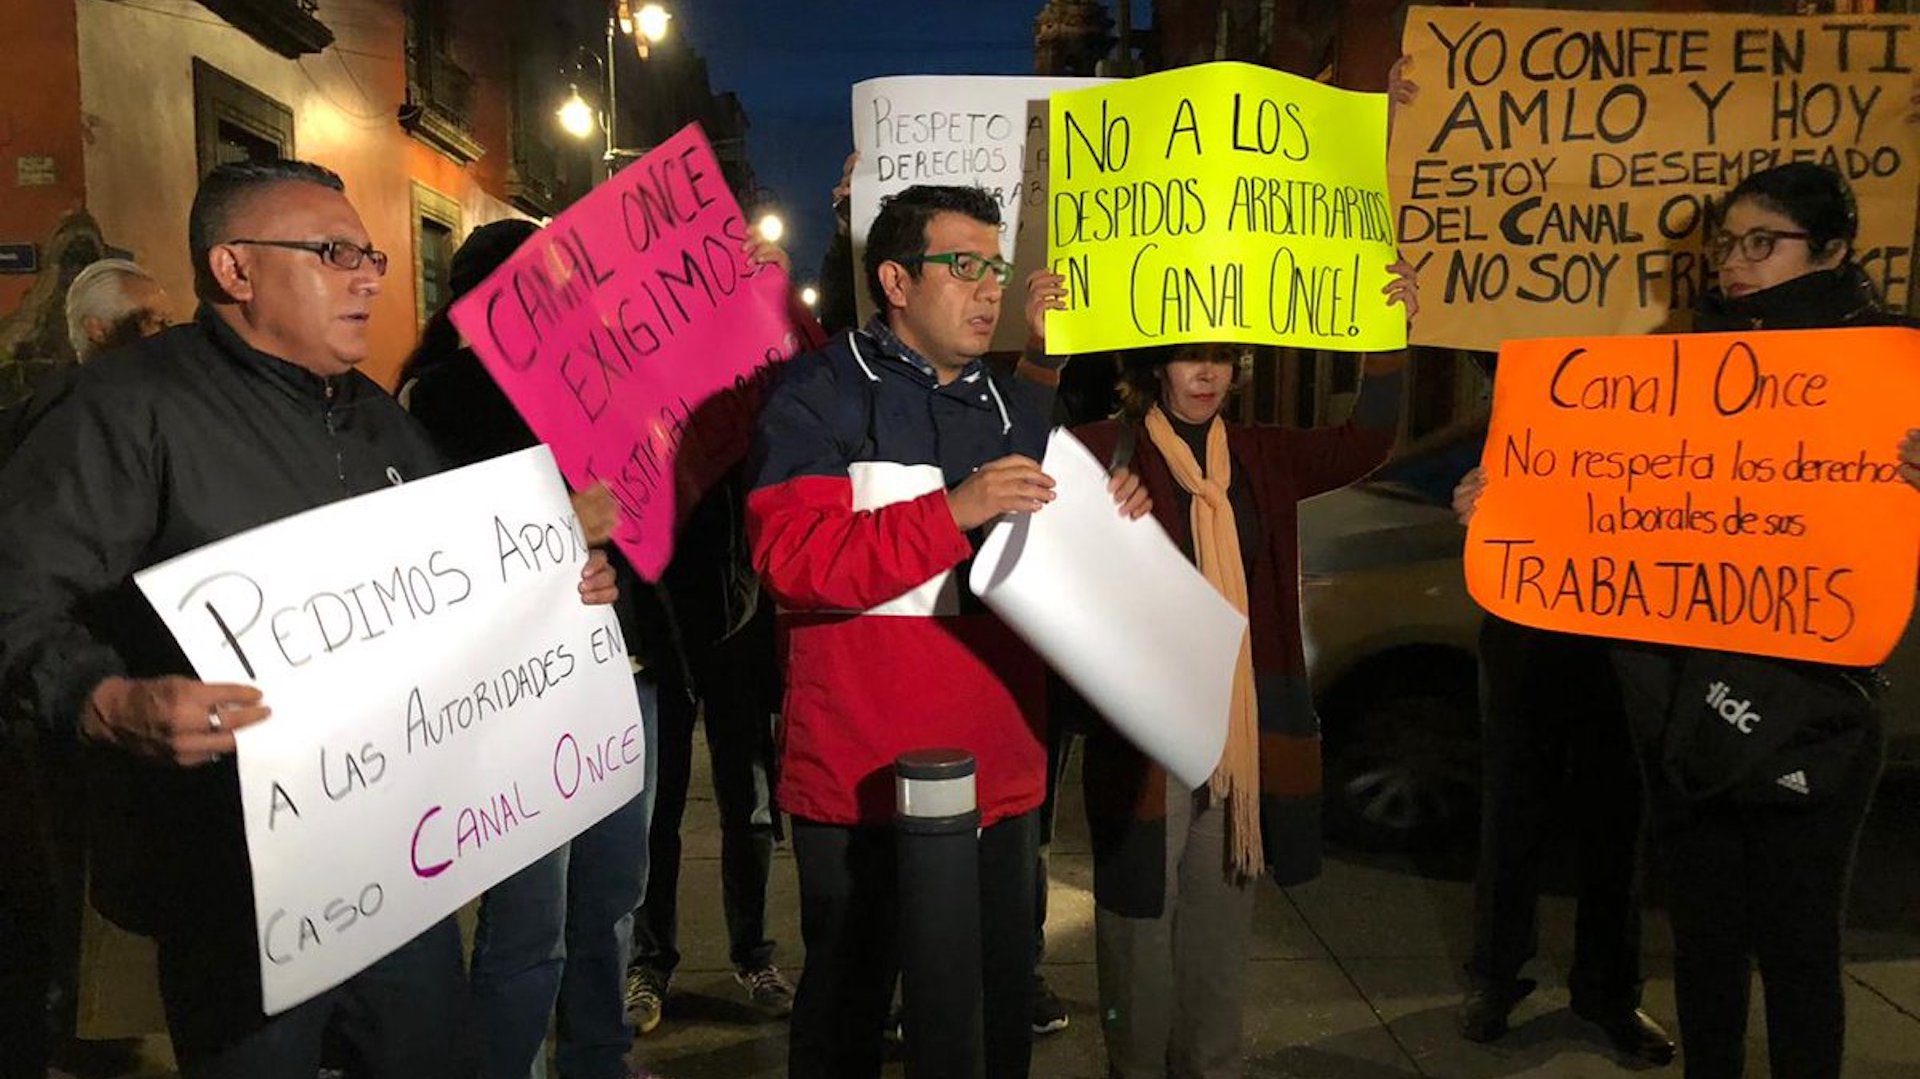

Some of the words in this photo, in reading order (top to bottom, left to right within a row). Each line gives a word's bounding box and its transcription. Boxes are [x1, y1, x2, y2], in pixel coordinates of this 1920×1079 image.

[1427, 21, 1507, 90] YO
[1520, 26, 1709, 82] CONFIE
[1733, 27, 1805, 76] EN
[1822, 22, 1912, 74] TI
[873, 97, 1012, 148] RESPETO
[1027, 115, 1044, 138] A
[1063, 98, 1131, 180] NO
[1165, 97, 1203, 159] A
[1231, 92, 1310, 162] LOS
[1427, 82, 1649, 153] AMLO
[1688, 80, 1735, 145] Y
[1770, 80, 1883, 145] HOY
[877, 146, 1008, 182] DERECHOS
[1411, 155, 1557, 200] ESTOY
[1054, 177, 1206, 248] DESPIDOS
[1228, 175, 1395, 247] ARBITRARIOS
[1398, 203, 1489, 245] DEL
[1498, 197, 1645, 247] CANAL
[485, 226, 617, 374] CANAL
[620, 145, 716, 254] ONCE
[1129, 242, 1252, 338] CANAL
[1268, 245, 1361, 338] ONCE!
[1442, 248, 1510, 305] NO
[1515, 248, 1622, 305] SOY
[559, 214, 756, 426] EXIGIMOS
[1549, 338, 1681, 418] Canal
[1713, 340, 1829, 417] Once
[1502, 427, 1557, 478] No
[1569, 438, 1715, 493] respeta
[1731, 439, 1777, 484] los
[1782, 439, 1905, 485] derecho
[1586, 491, 1718, 536] laborales
[1722, 496, 1756, 536] de
[1766, 511, 1807, 537] sus
[178, 550, 471, 680] PEDIMOS
[1483, 538, 1856, 643] TRABAJADORES
[268, 780, 300, 831] A
[319, 742, 387, 801] LAS
[406, 644, 576, 755] AUTORIDADES
[590, 624, 623, 665] EN
[262, 882, 385, 966] CASO
[409, 781, 541, 879] CANAL
[552, 722, 642, 799] ONCE
